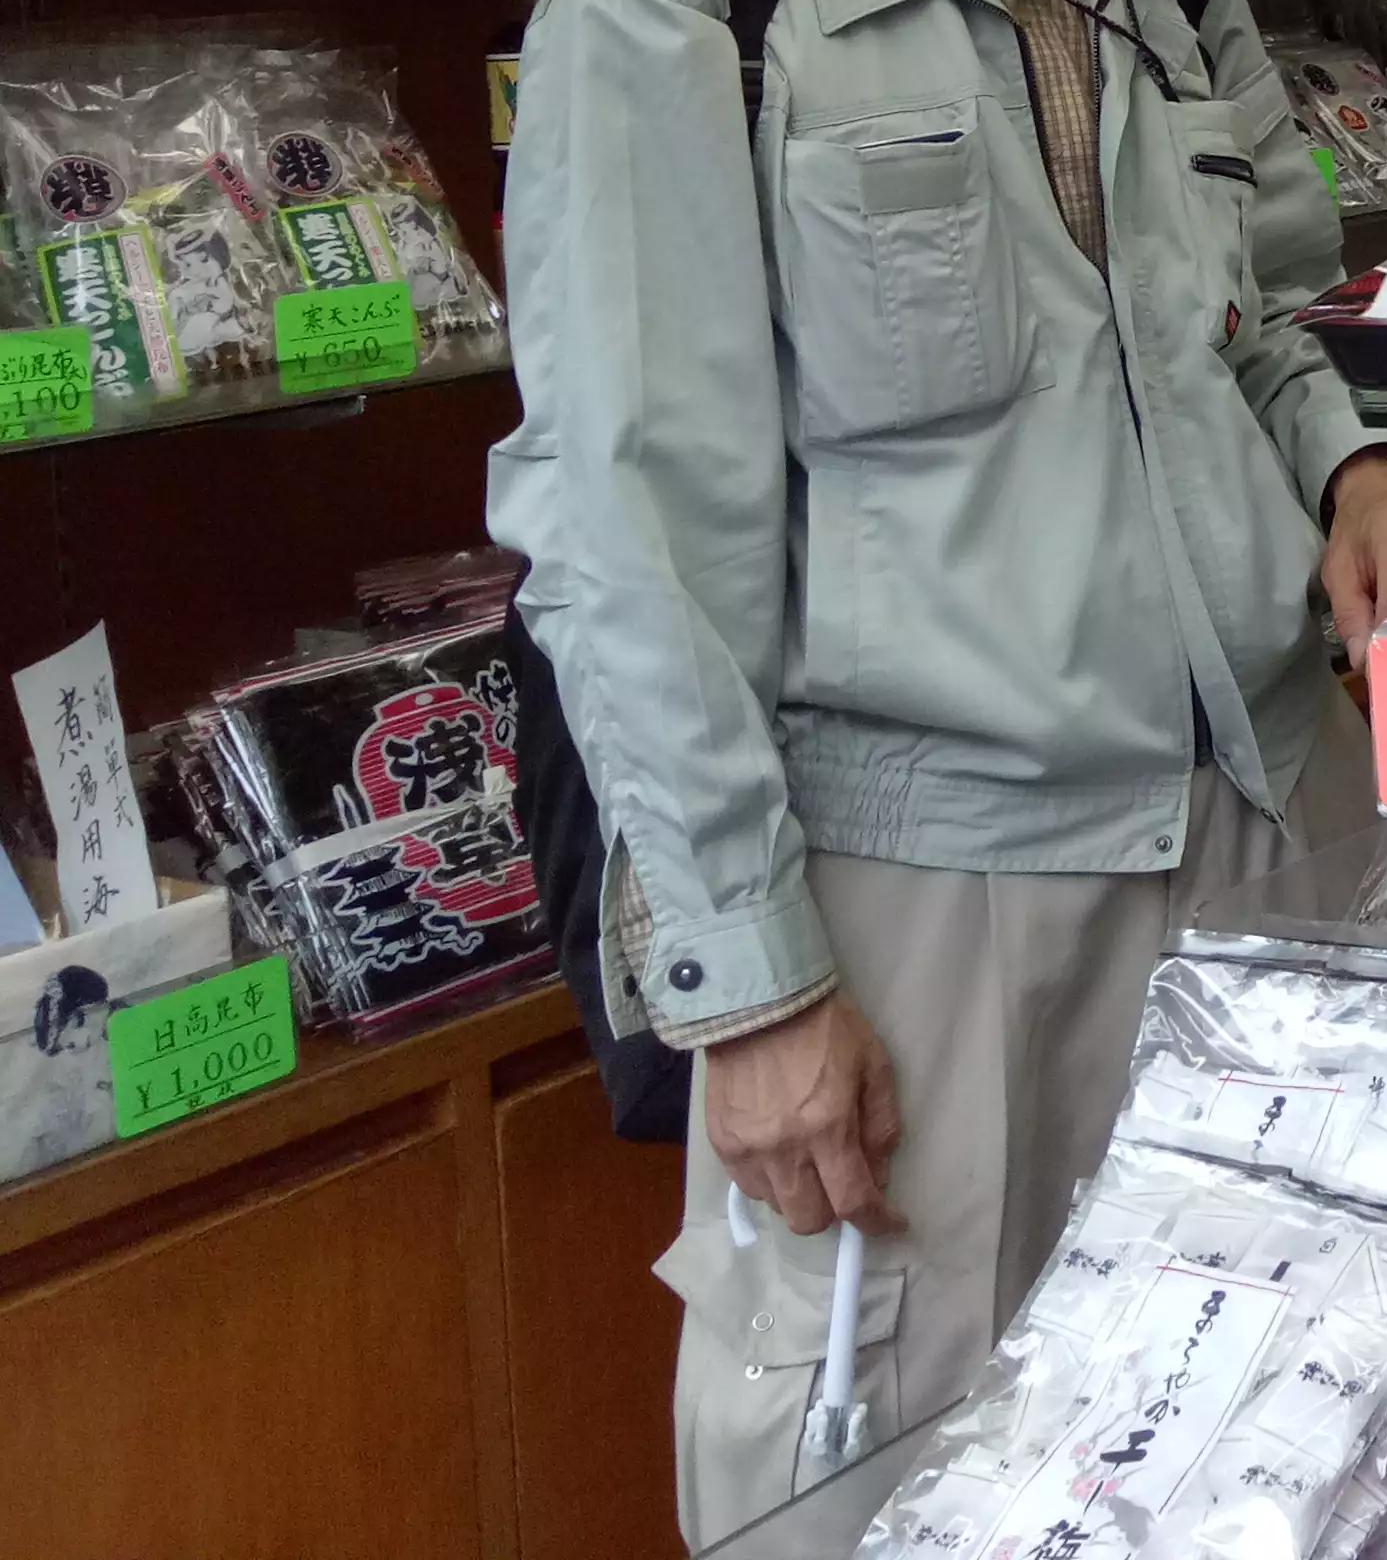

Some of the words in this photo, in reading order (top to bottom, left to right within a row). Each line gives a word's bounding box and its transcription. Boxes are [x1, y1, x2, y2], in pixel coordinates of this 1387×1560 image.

[301, 292, 401, 334] 寒天こんぶ
[153, 980, 266, 1054] 日高昆布
